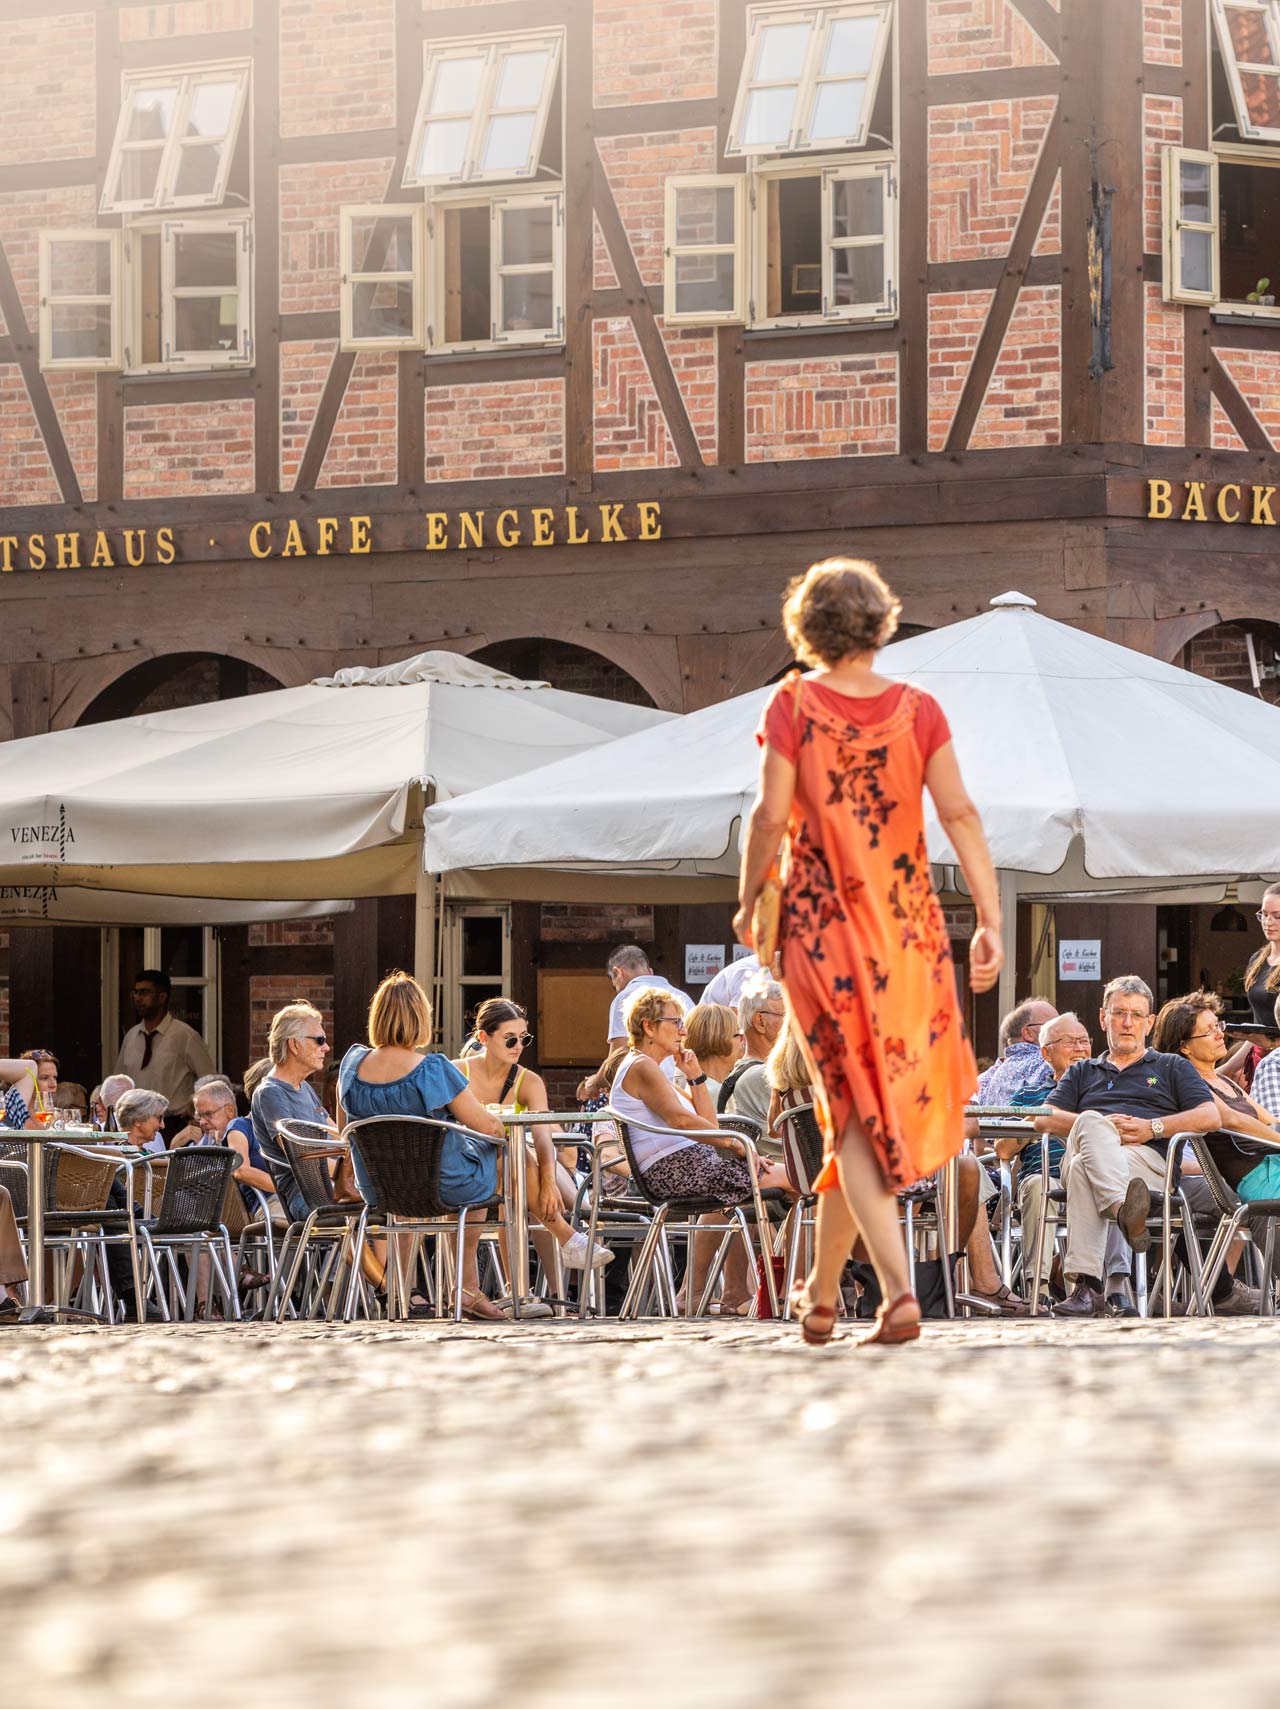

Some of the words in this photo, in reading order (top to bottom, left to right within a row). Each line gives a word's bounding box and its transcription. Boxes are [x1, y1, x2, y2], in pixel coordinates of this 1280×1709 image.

[0, 526, 176, 573] TSHAUS
[247, 514, 373, 560] CAFE
[424, 500, 663, 551] ENGELKE
